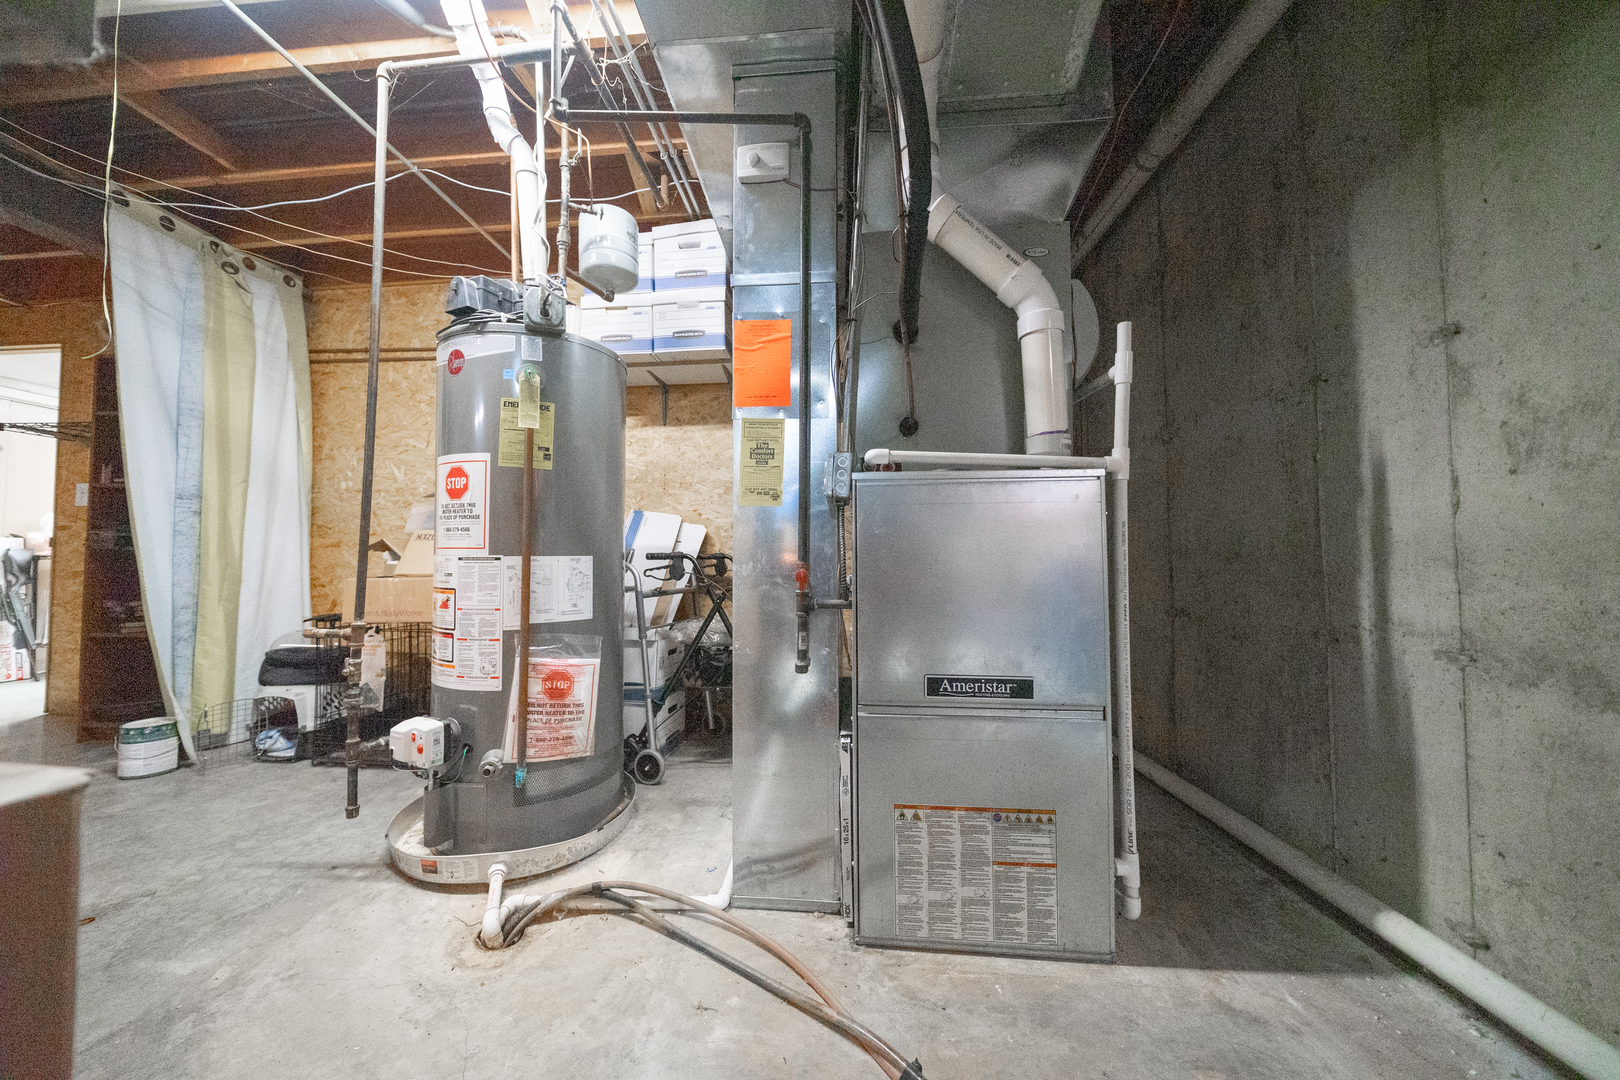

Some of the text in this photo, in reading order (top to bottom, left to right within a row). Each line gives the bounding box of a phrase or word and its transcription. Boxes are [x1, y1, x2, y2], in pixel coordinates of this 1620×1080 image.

[446, 477, 466, 490] STOP
[545, 680, 571, 690] STOP
[940, 679, 1013, 694] Ameristar
